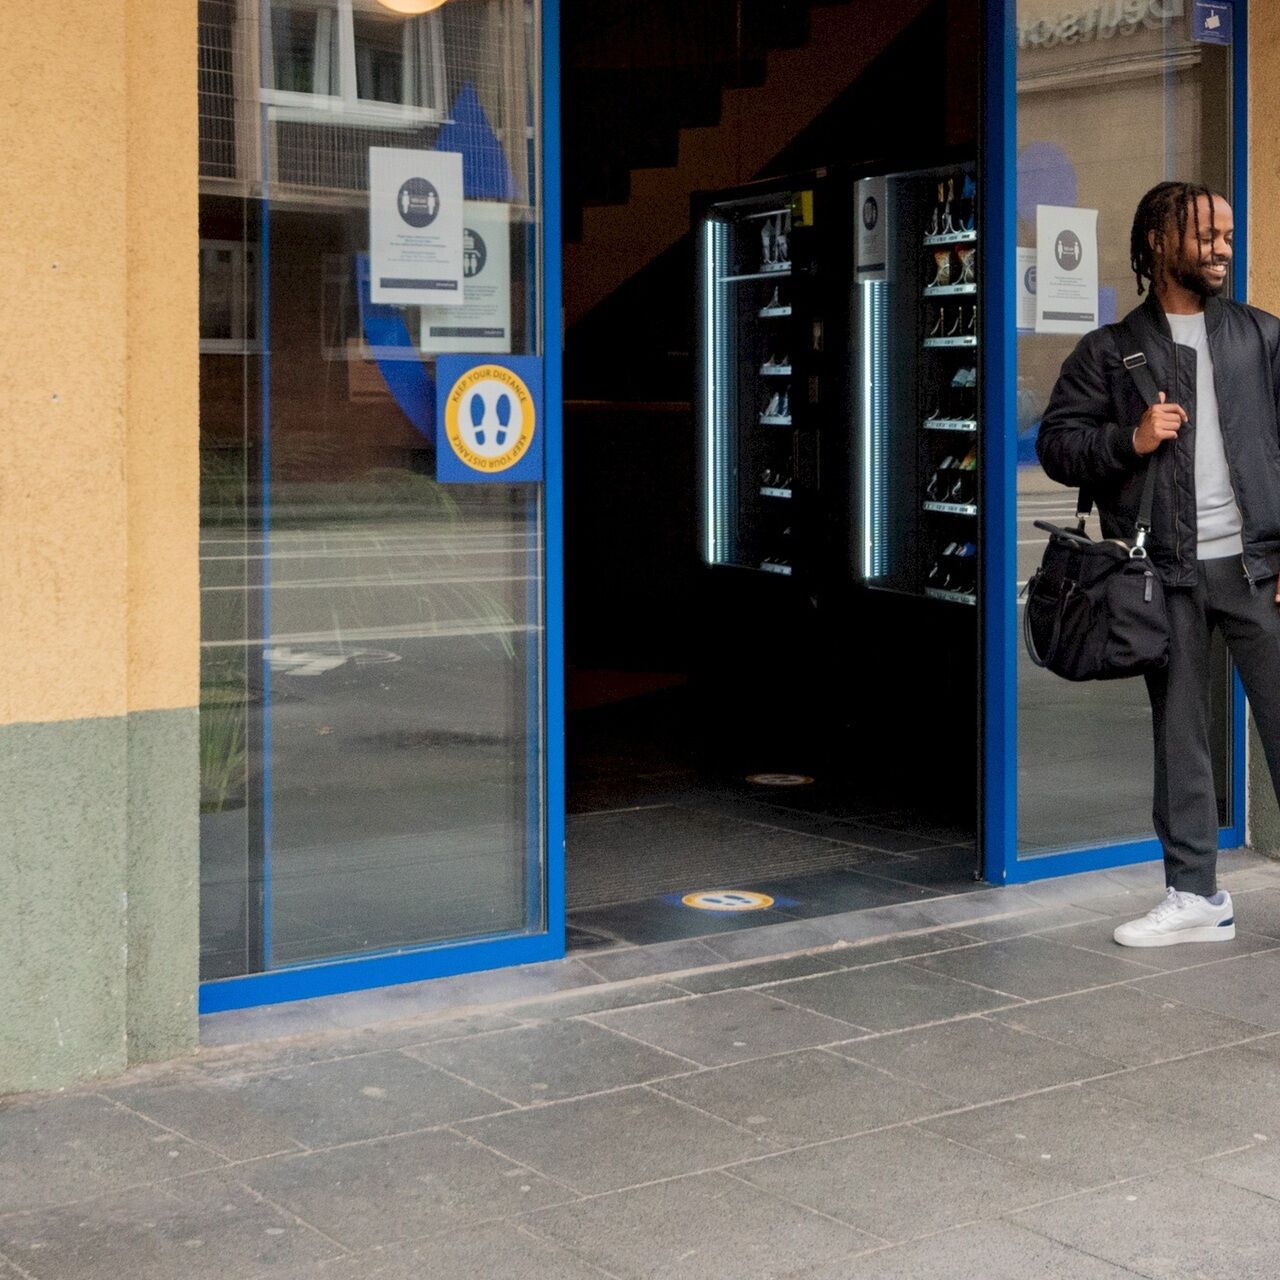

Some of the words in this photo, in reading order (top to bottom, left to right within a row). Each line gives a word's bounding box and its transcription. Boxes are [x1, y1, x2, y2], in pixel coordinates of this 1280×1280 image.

[453, 380, 467, 403] KEEP
[468, 368, 491, 382] YOUR
[492, 368, 528, 404] DISTANCE
